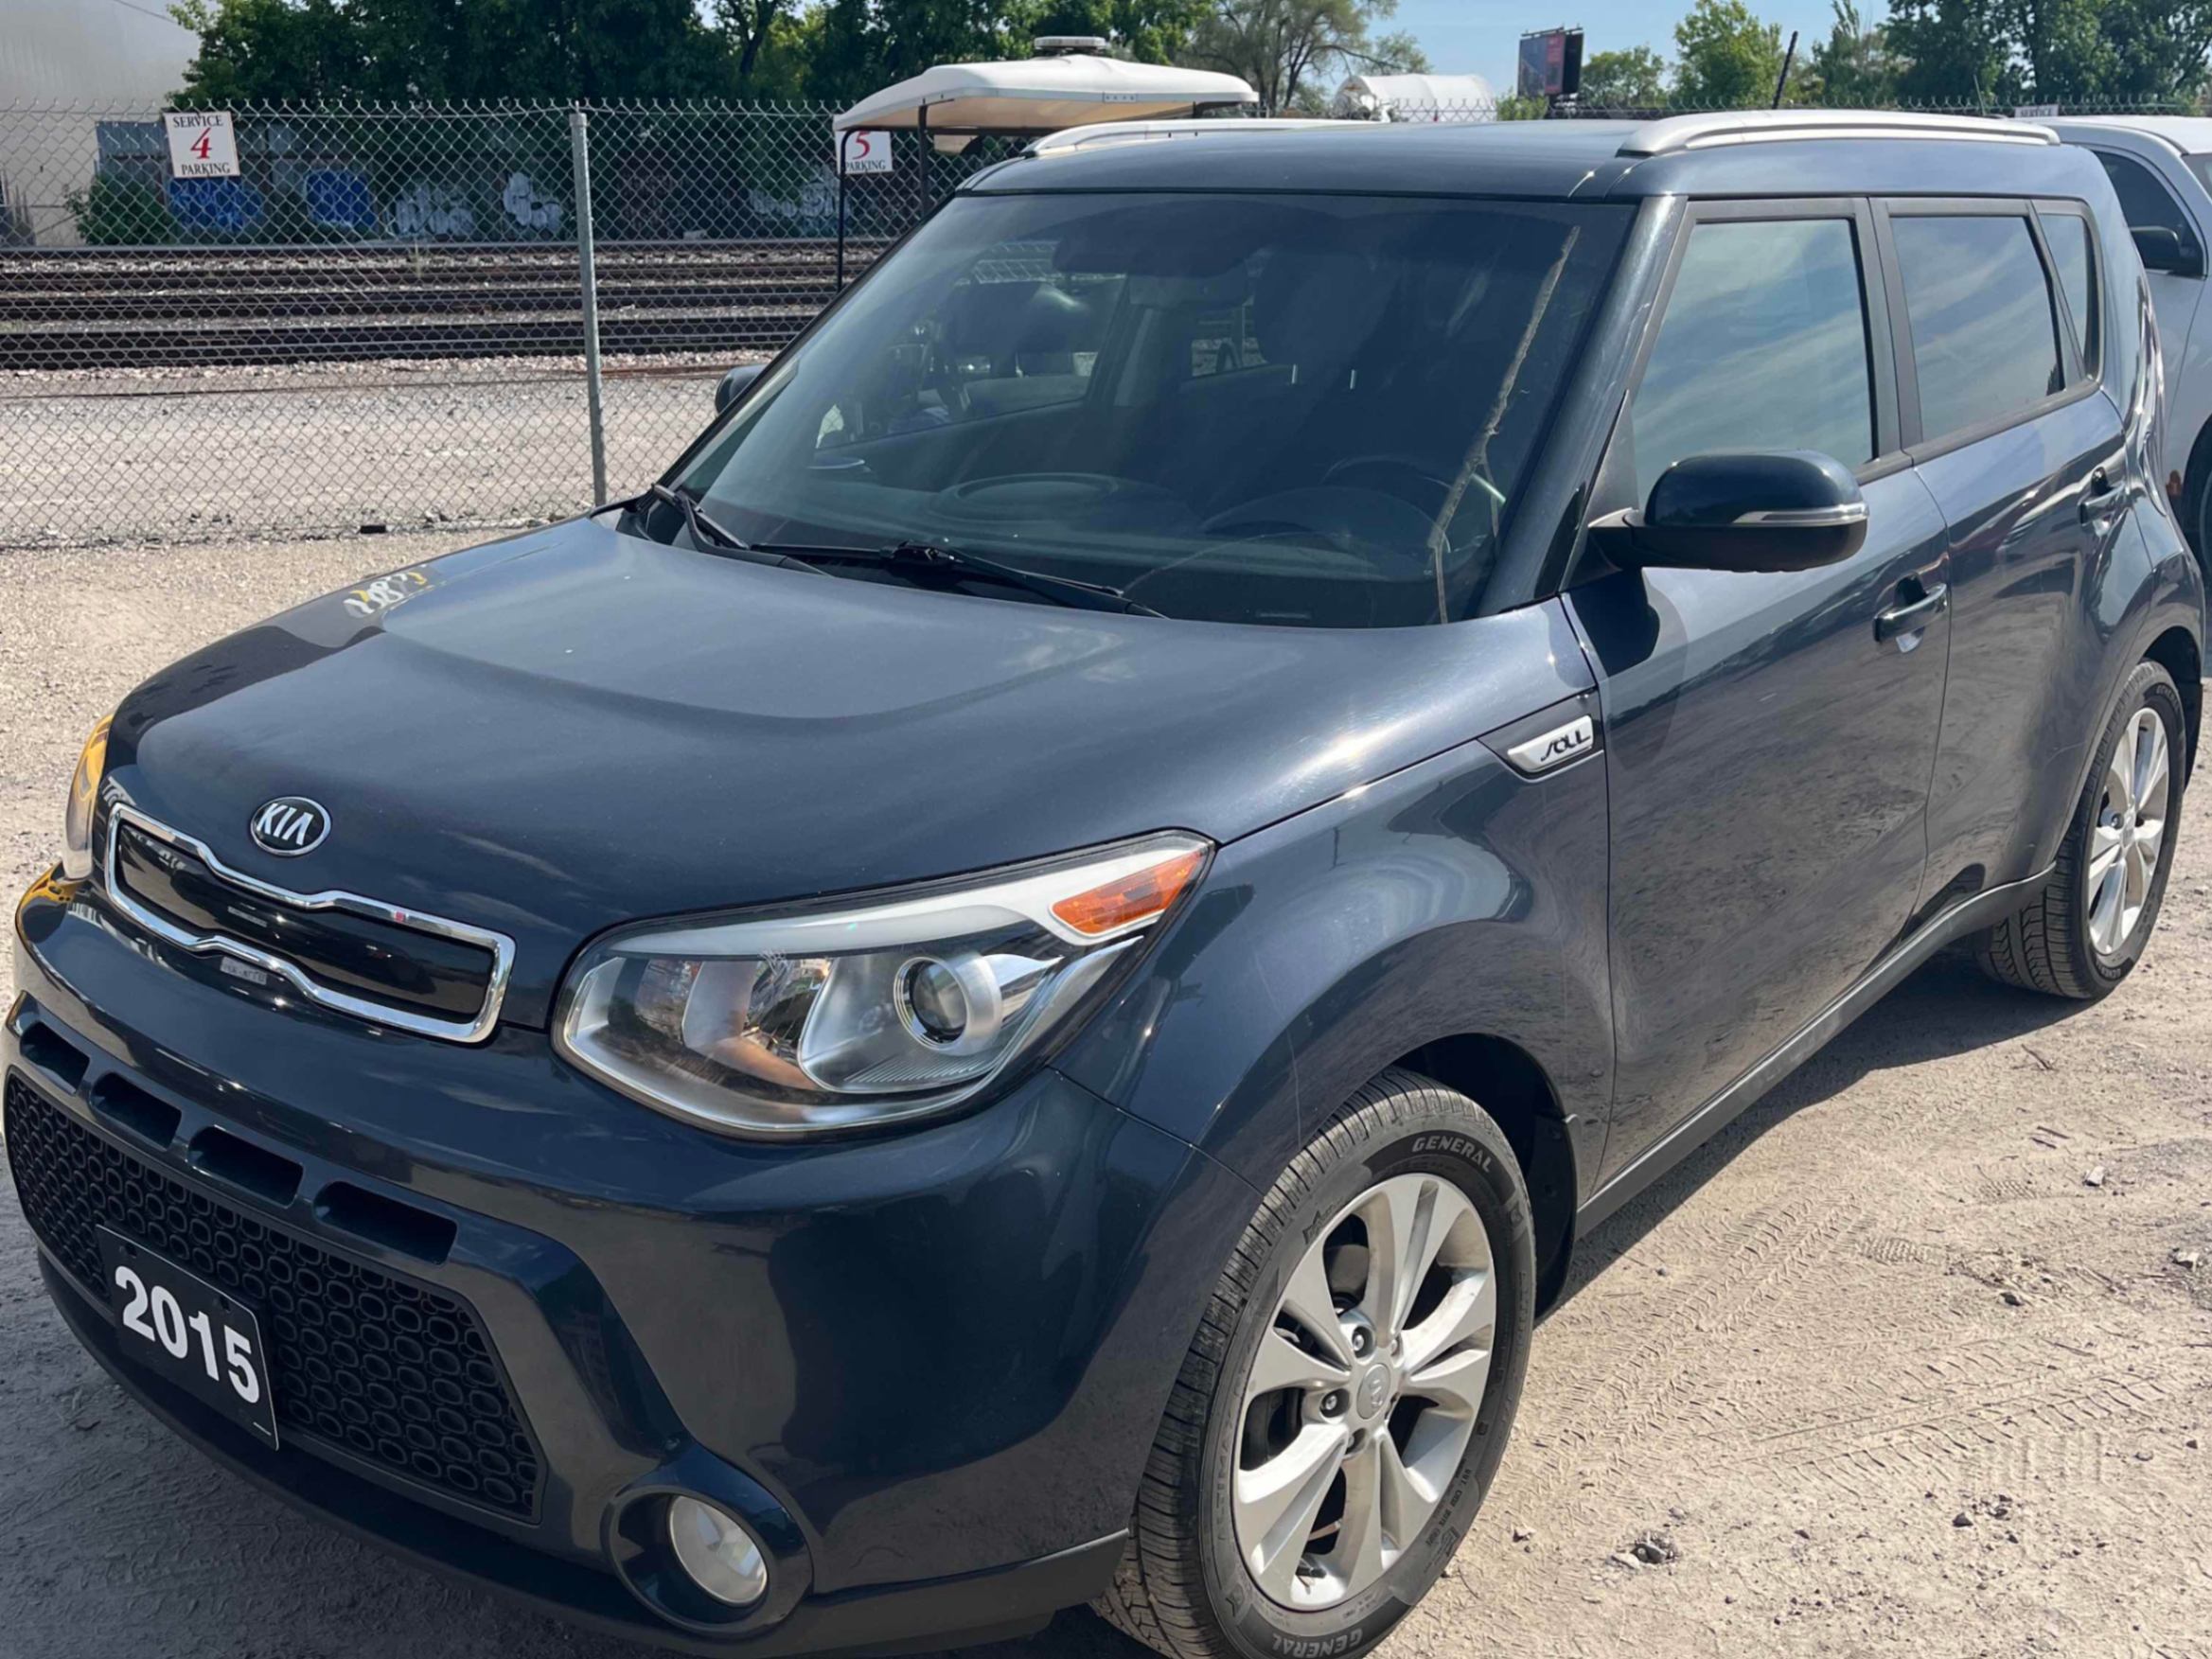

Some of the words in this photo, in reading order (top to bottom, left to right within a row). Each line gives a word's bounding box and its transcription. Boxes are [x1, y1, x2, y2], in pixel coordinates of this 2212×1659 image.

[172, 115, 224, 128] SERVICE
[190, 127, 212, 159] 4
[853, 129, 871, 160] 5
[181, 162, 231, 175] PARKING
[256, 803, 314, 846] KIA
[1411, 1135, 1494, 1174] GENERAL
[115, 1265, 260, 1404] 2015
[1271, 1628, 1364, 1659] GENERAL
